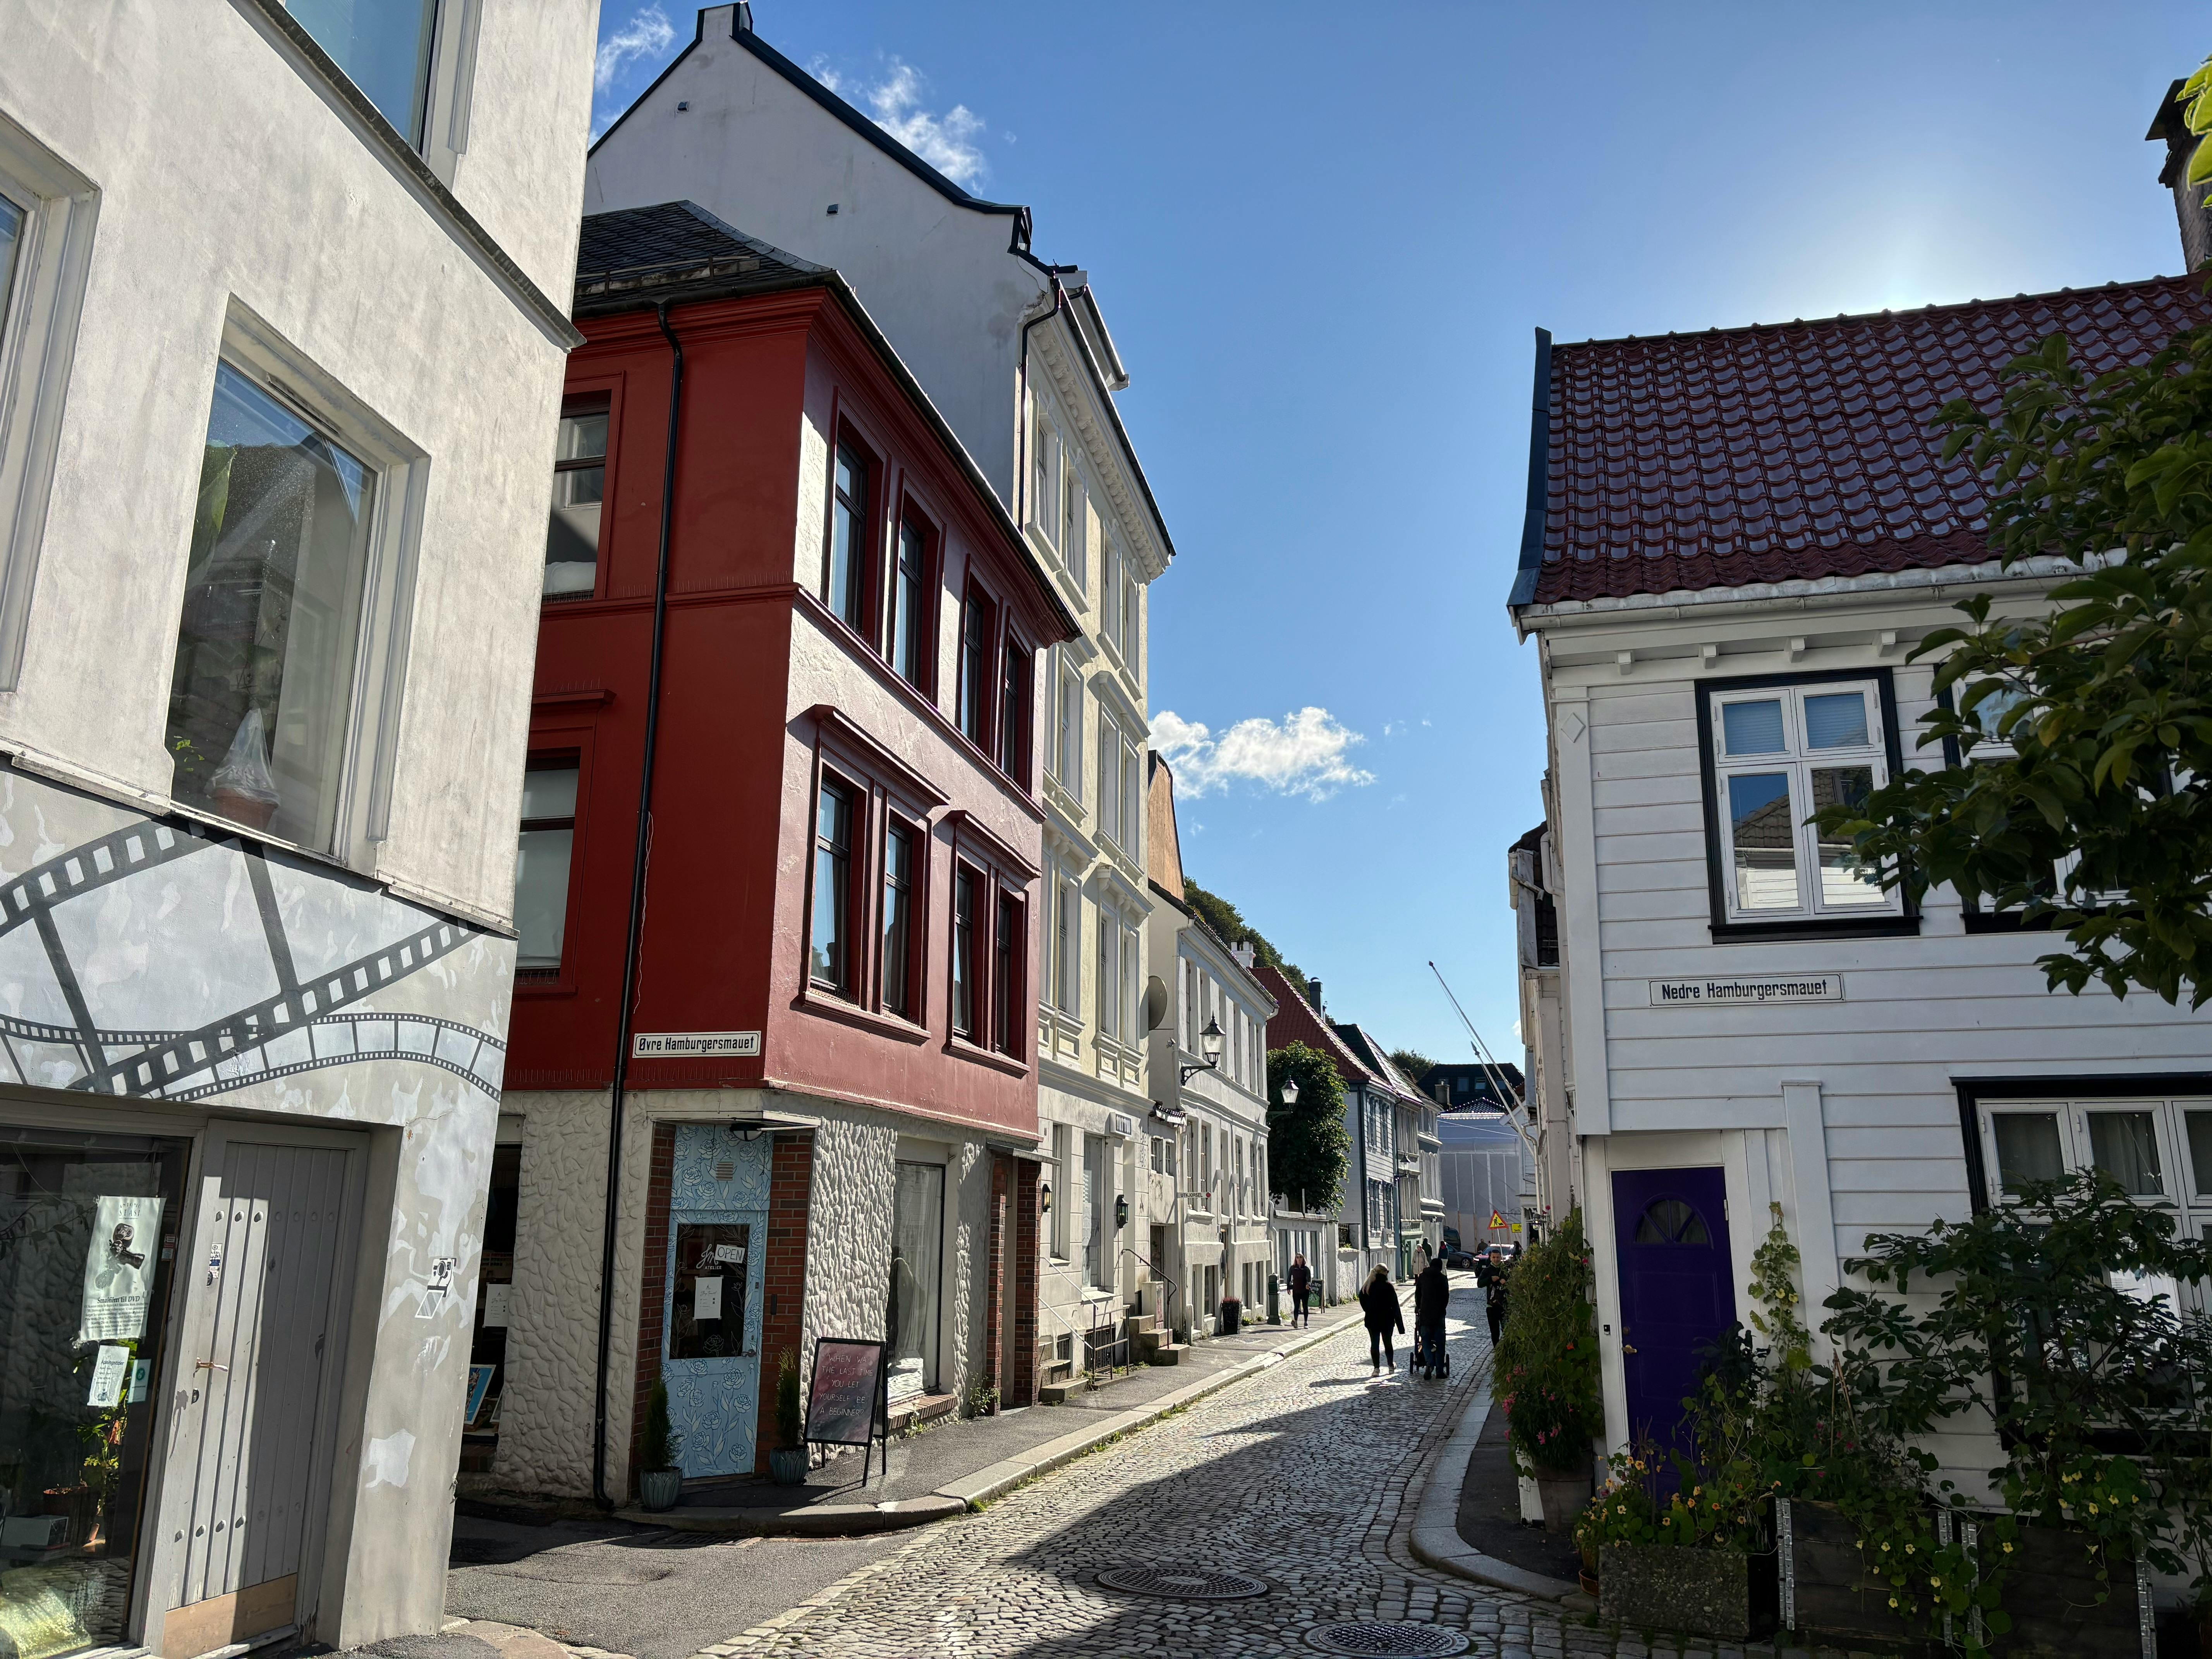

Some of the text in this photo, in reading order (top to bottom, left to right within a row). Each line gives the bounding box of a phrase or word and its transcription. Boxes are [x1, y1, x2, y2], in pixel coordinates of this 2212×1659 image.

[1662, 979, 1827, 1000] Nedre Hamburgersmauet
[639, 1036, 754, 1053] Øvre Hamburgersmauet
[718, 1247, 742, 1261] OPEN
[829, 1354, 851, 1362] WHEN
[819, 1393, 851, 1401] YOURSELF
[829, 1407, 864, 1416] BEGINNER?
